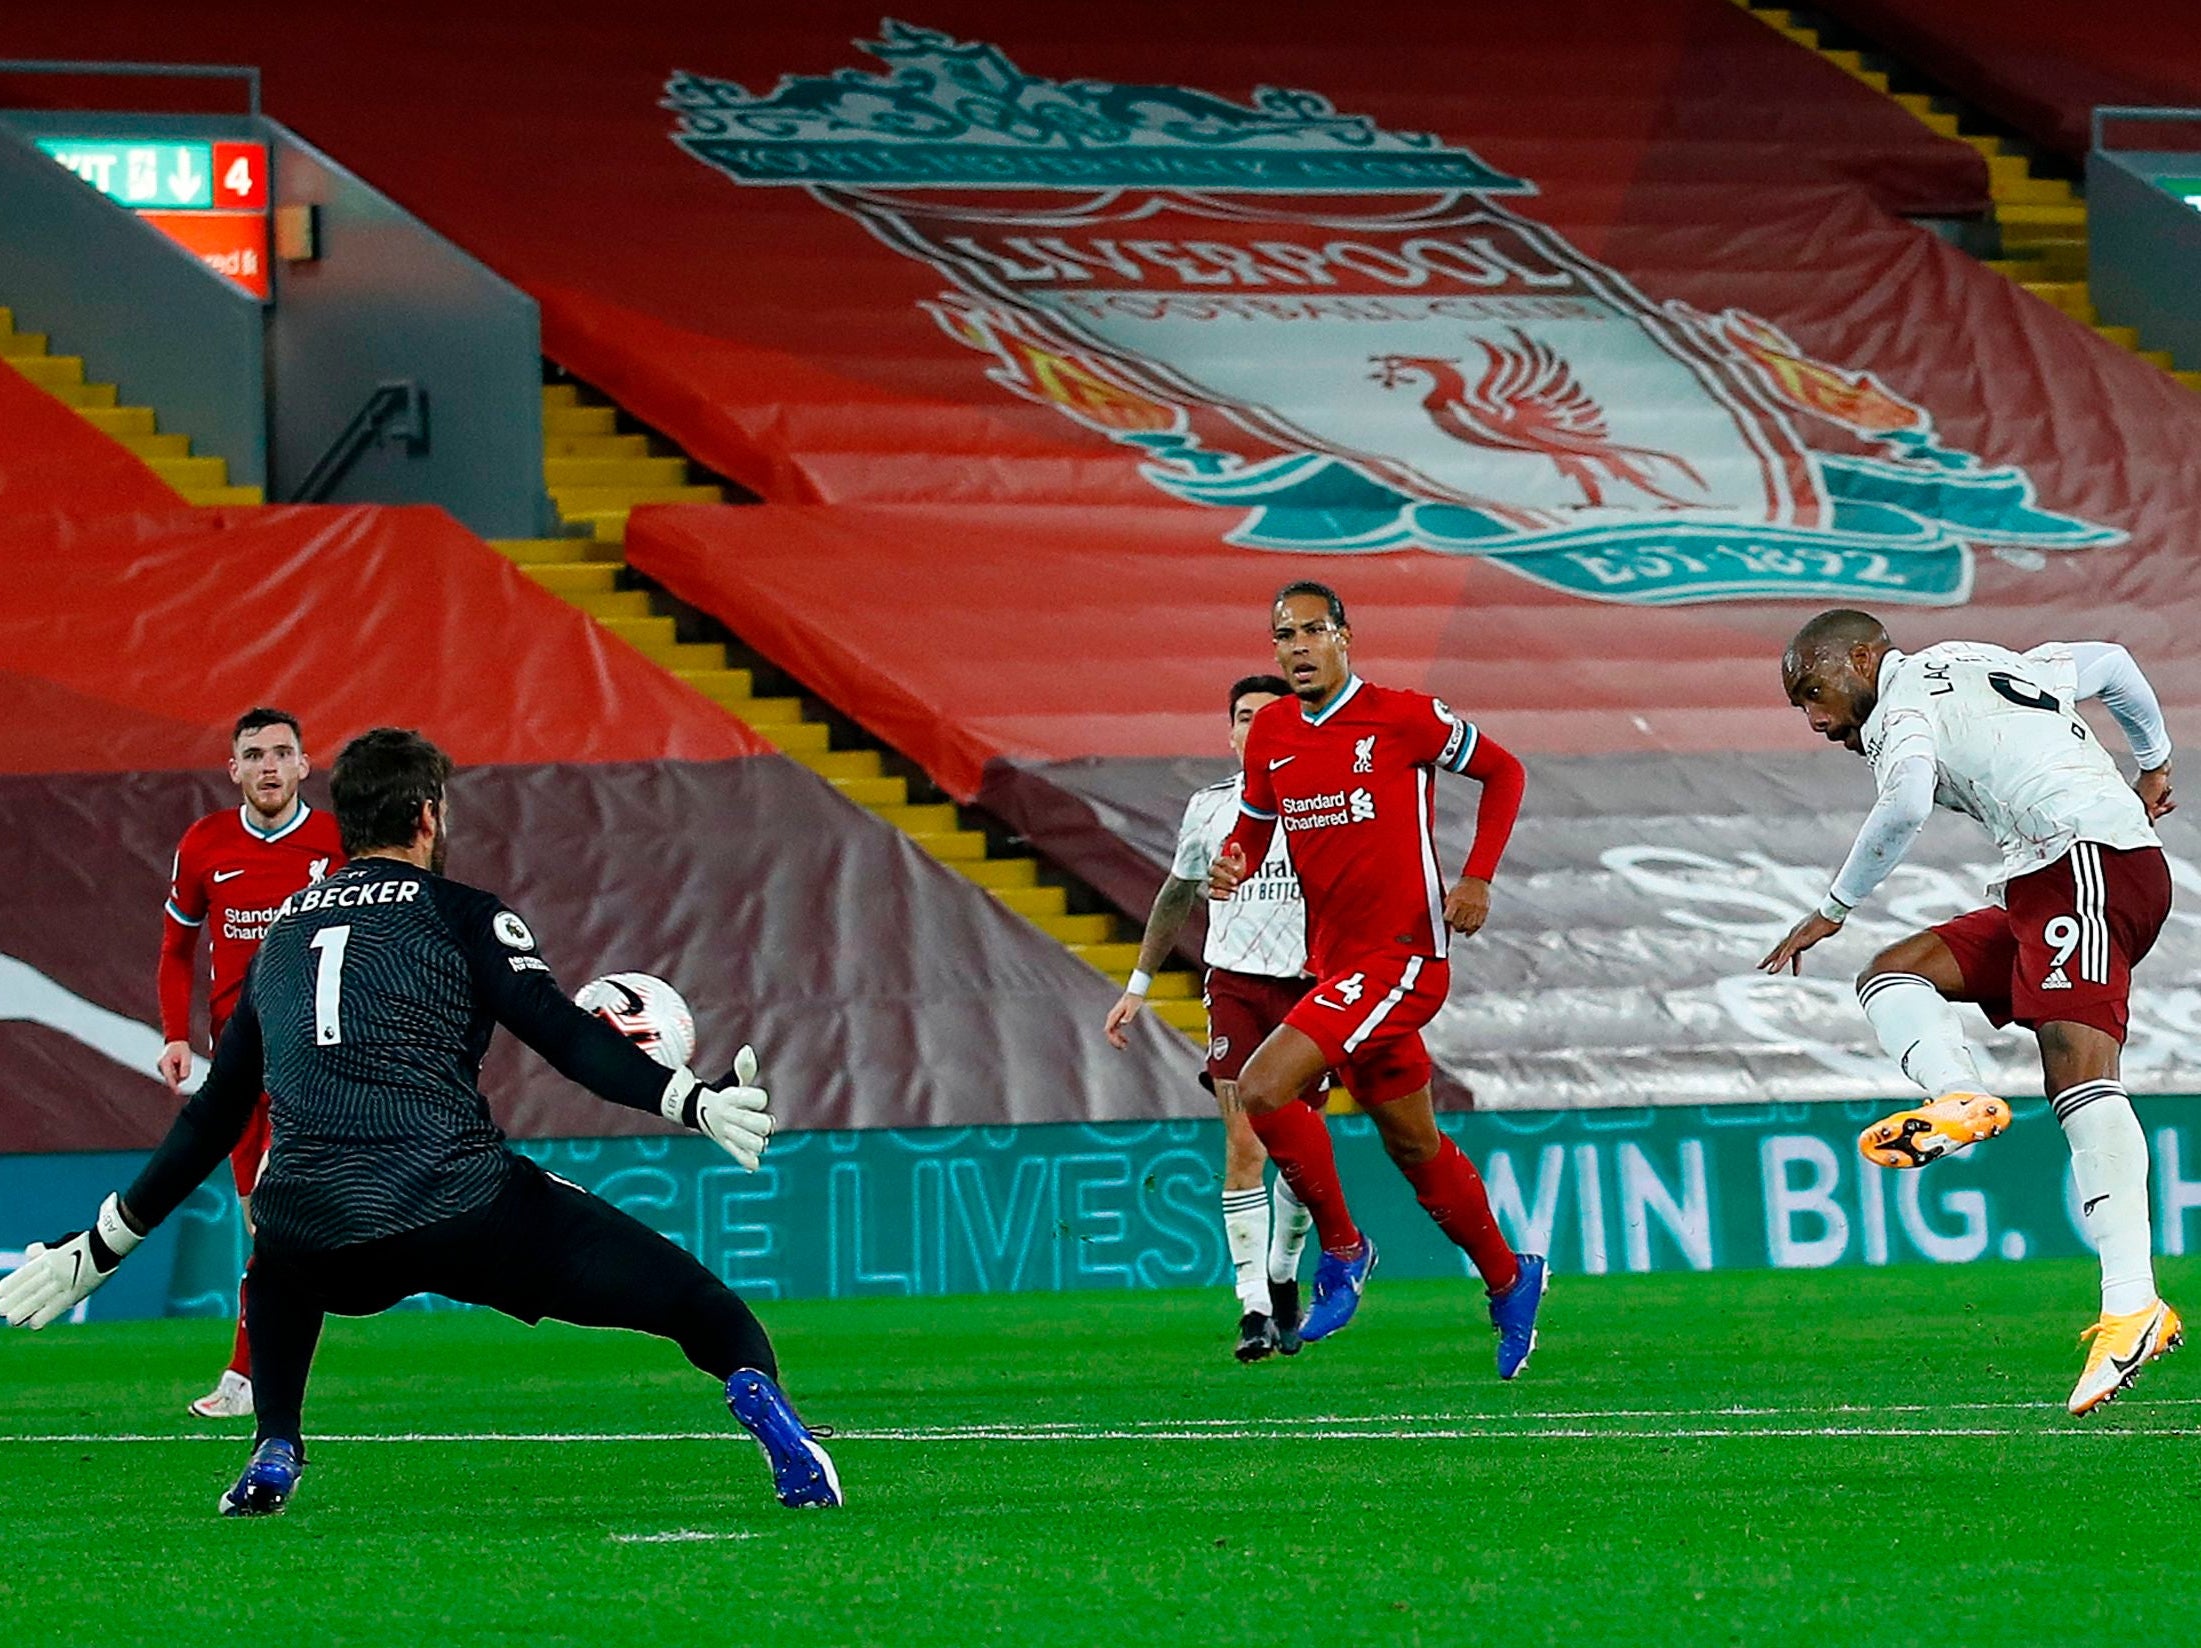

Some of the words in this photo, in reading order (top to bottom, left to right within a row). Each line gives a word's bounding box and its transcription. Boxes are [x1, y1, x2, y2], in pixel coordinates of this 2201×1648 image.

[223, 156, 253, 197] 4
[944, 236, 1573, 287] LIVERPOOL
[1282, 791, 1346, 814] Standard
[1284, 809, 1349, 831] Chartered
[274, 880, 420, 922] A.BECKER
[1259, 882, 1301, 901] BETTE
[224, 907, 279, 924] Stand
[2044, 915, 2080, 967] 9
[309, 924, 351, 1046] 1
[1335, 972, 1366, 1006] 4
[827, 1148, 1227, 1300] LIVES
[1463, 1138, 1713, 1284] WIN
[1757, 1124, 2028, 1270] BIG.
